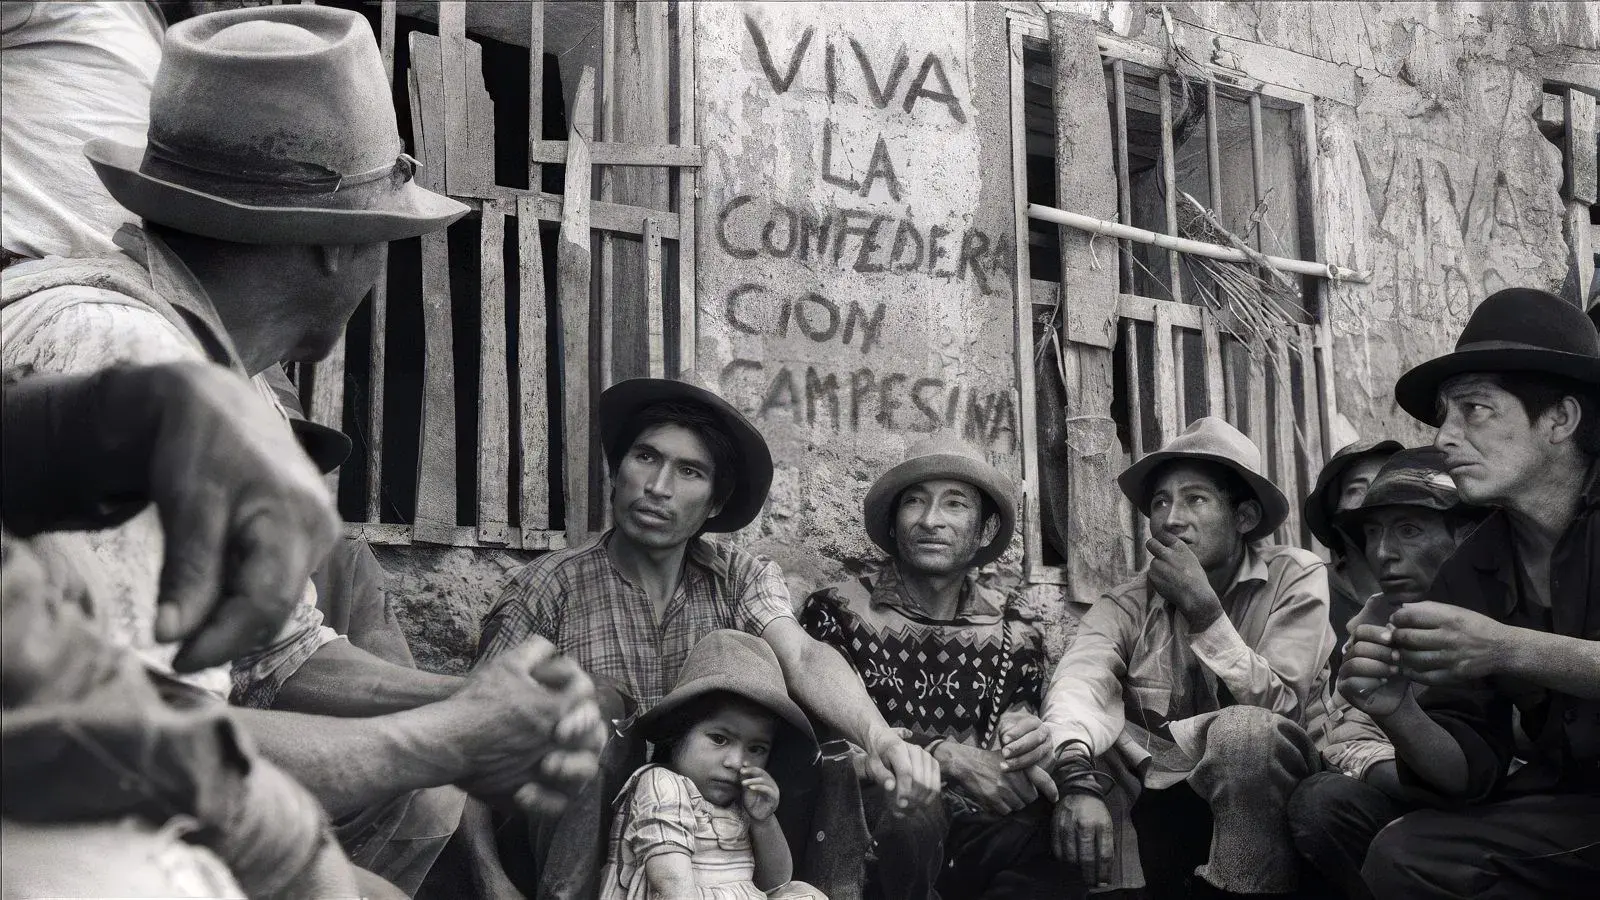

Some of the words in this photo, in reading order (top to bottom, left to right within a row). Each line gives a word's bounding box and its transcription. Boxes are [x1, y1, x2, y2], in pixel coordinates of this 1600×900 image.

[744, 13, 968, 124] VIVA
[821, 116, 903, 202] LA
[715, 194, 1015, 296] CONFEDERA
[725, 282, 887, 354] CION
